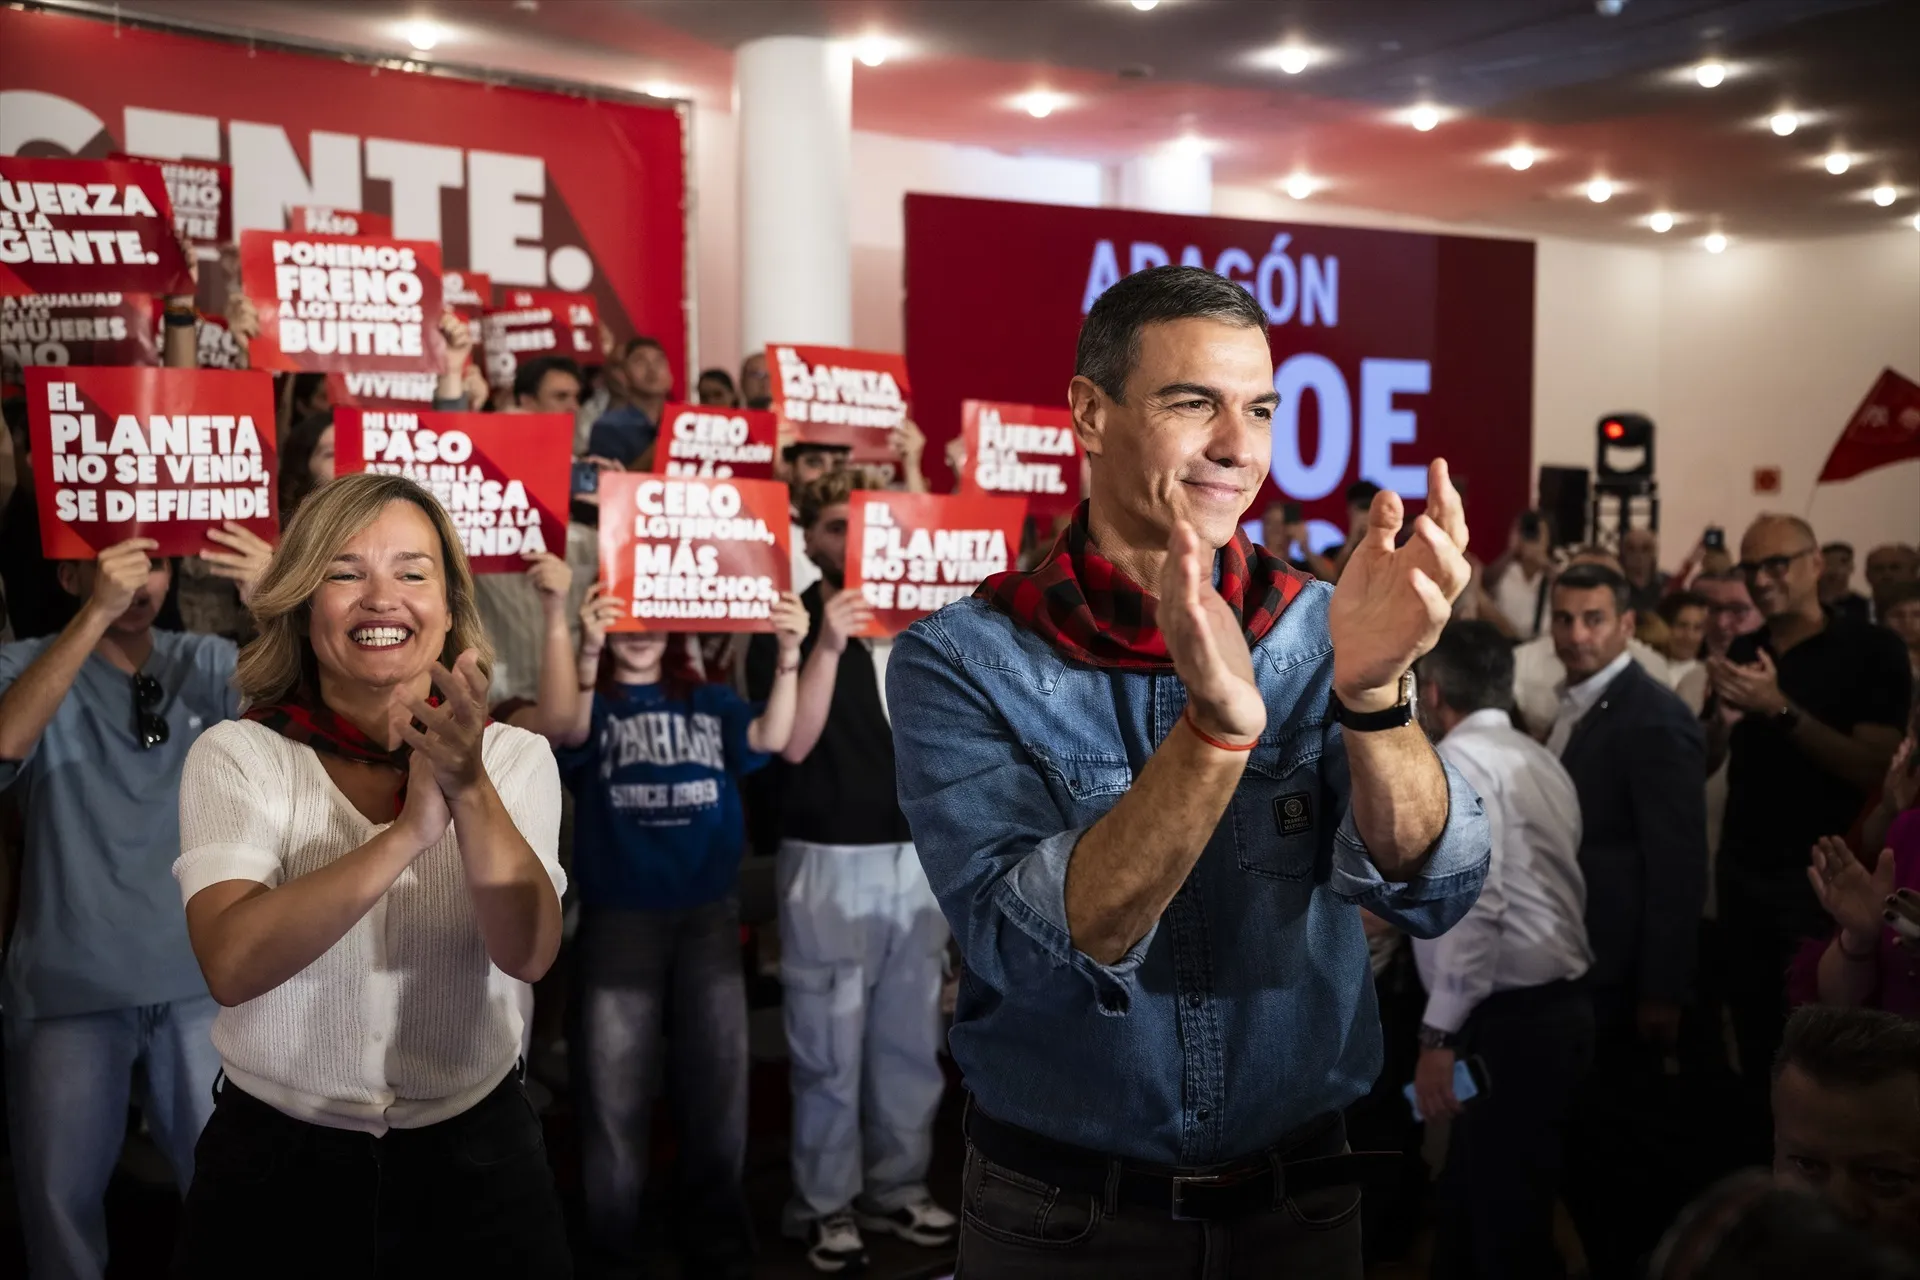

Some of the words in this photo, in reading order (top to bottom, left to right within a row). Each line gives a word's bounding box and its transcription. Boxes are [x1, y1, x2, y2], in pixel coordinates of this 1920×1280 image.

[18, 212, 54, 230] LA
[0, 229, 159, 265] GENTE.
[272, 239, 417, 272] PONEMOS
[275, 264, 423, 306] FRENO
[279, 300, 295, 319] A
[297, 301, 338, 320] LOS
[339, 303, 423, 324] FONDOS
[0, 316, 127, 341] MUJERES
[279, 318, 423, 357] BUITRE
[47, 382, 84, 411] EL
[50, 414, 262, 455] PLANETA
[362, 412, 386, 430] NI
[387, 413, 419, 431] UN
[672, 411, 749, 447] CERO
[362, 428, 473, 464] PASO
[979, 424, 1075, 456] FUERZA
[53, 455, 108, 483] NO
[115, 455, 157, 484] SE
[164, 455, 270, 486] VENDE,
[430, 465, 456, 481] EN
[458, 465, 485, 481] LA
[975, 462, 1067, 495] GENTE.
[55, 489, 98, 522] SE
[105, 488, 269, 522] DEFIENDE
[636, 480, 742, 519] CERO
[864, 502, 894, 526] EL
[498, 511, 515, 528] A
[516, 508, 542, 527] LA
[634, 537, 719, 577] MÁS
[863, 526, 1008, 561] PLANETA
[861, 556, 905, 581] NO
[906, 559, 938, 583] SE
[633, 575, 780, 605] DERECHOS,
[861, 582, 895, 609] SE
[631, 601, 728, 619] IGUALDAD
